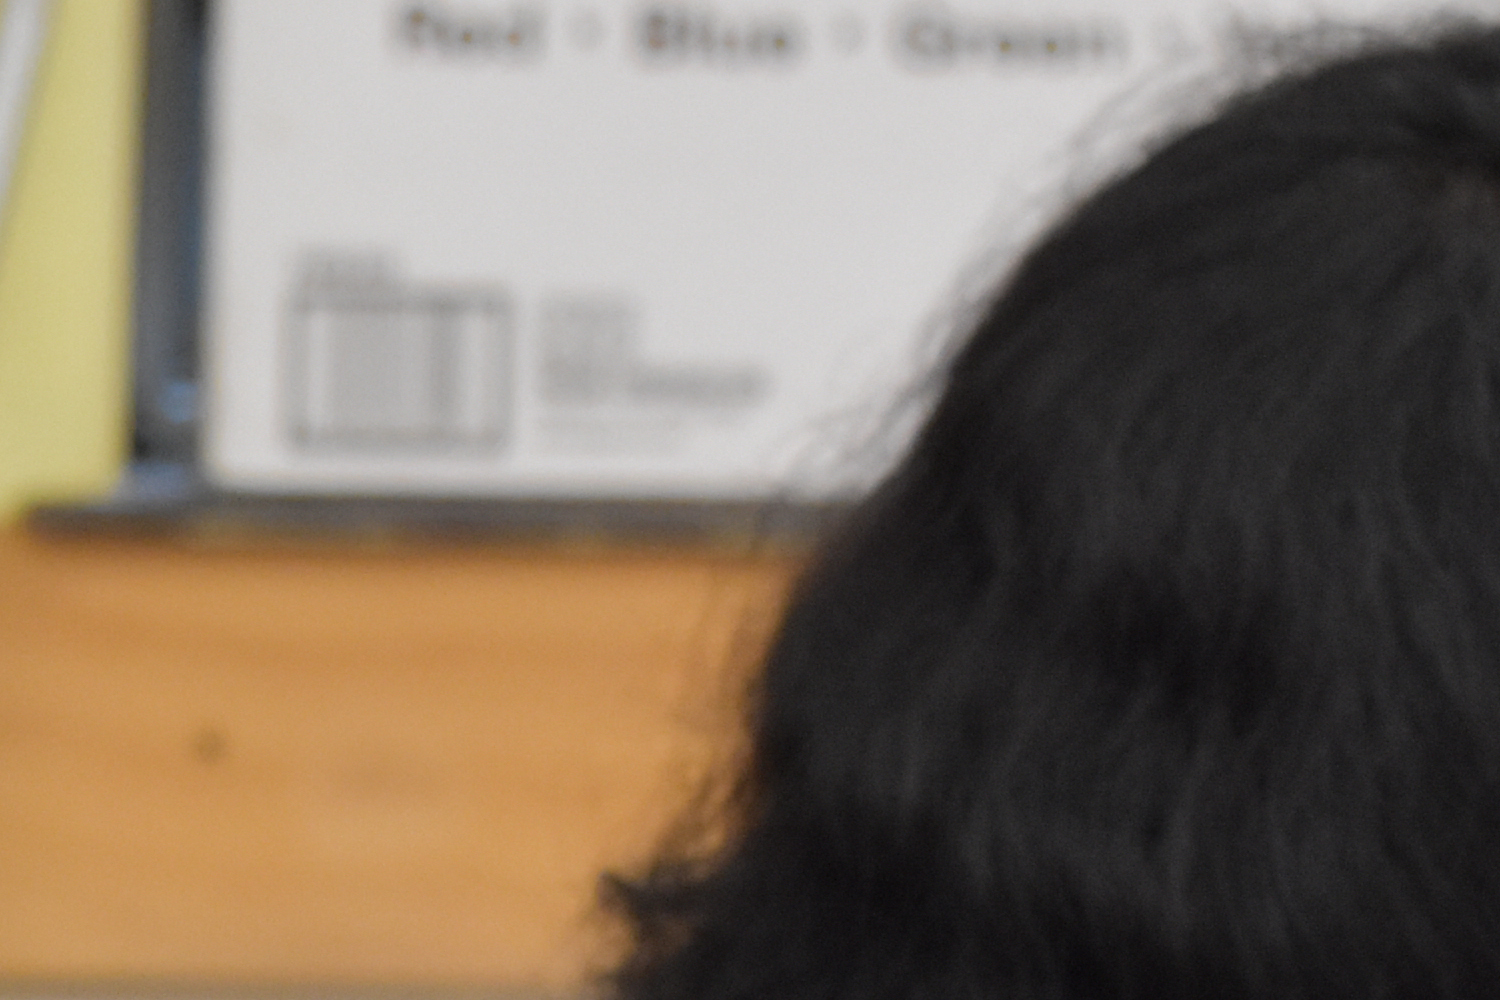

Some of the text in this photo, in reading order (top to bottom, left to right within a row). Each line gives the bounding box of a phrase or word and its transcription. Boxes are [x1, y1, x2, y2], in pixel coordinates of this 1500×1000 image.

[393, 0, 1127, 68] Red Blue Green
